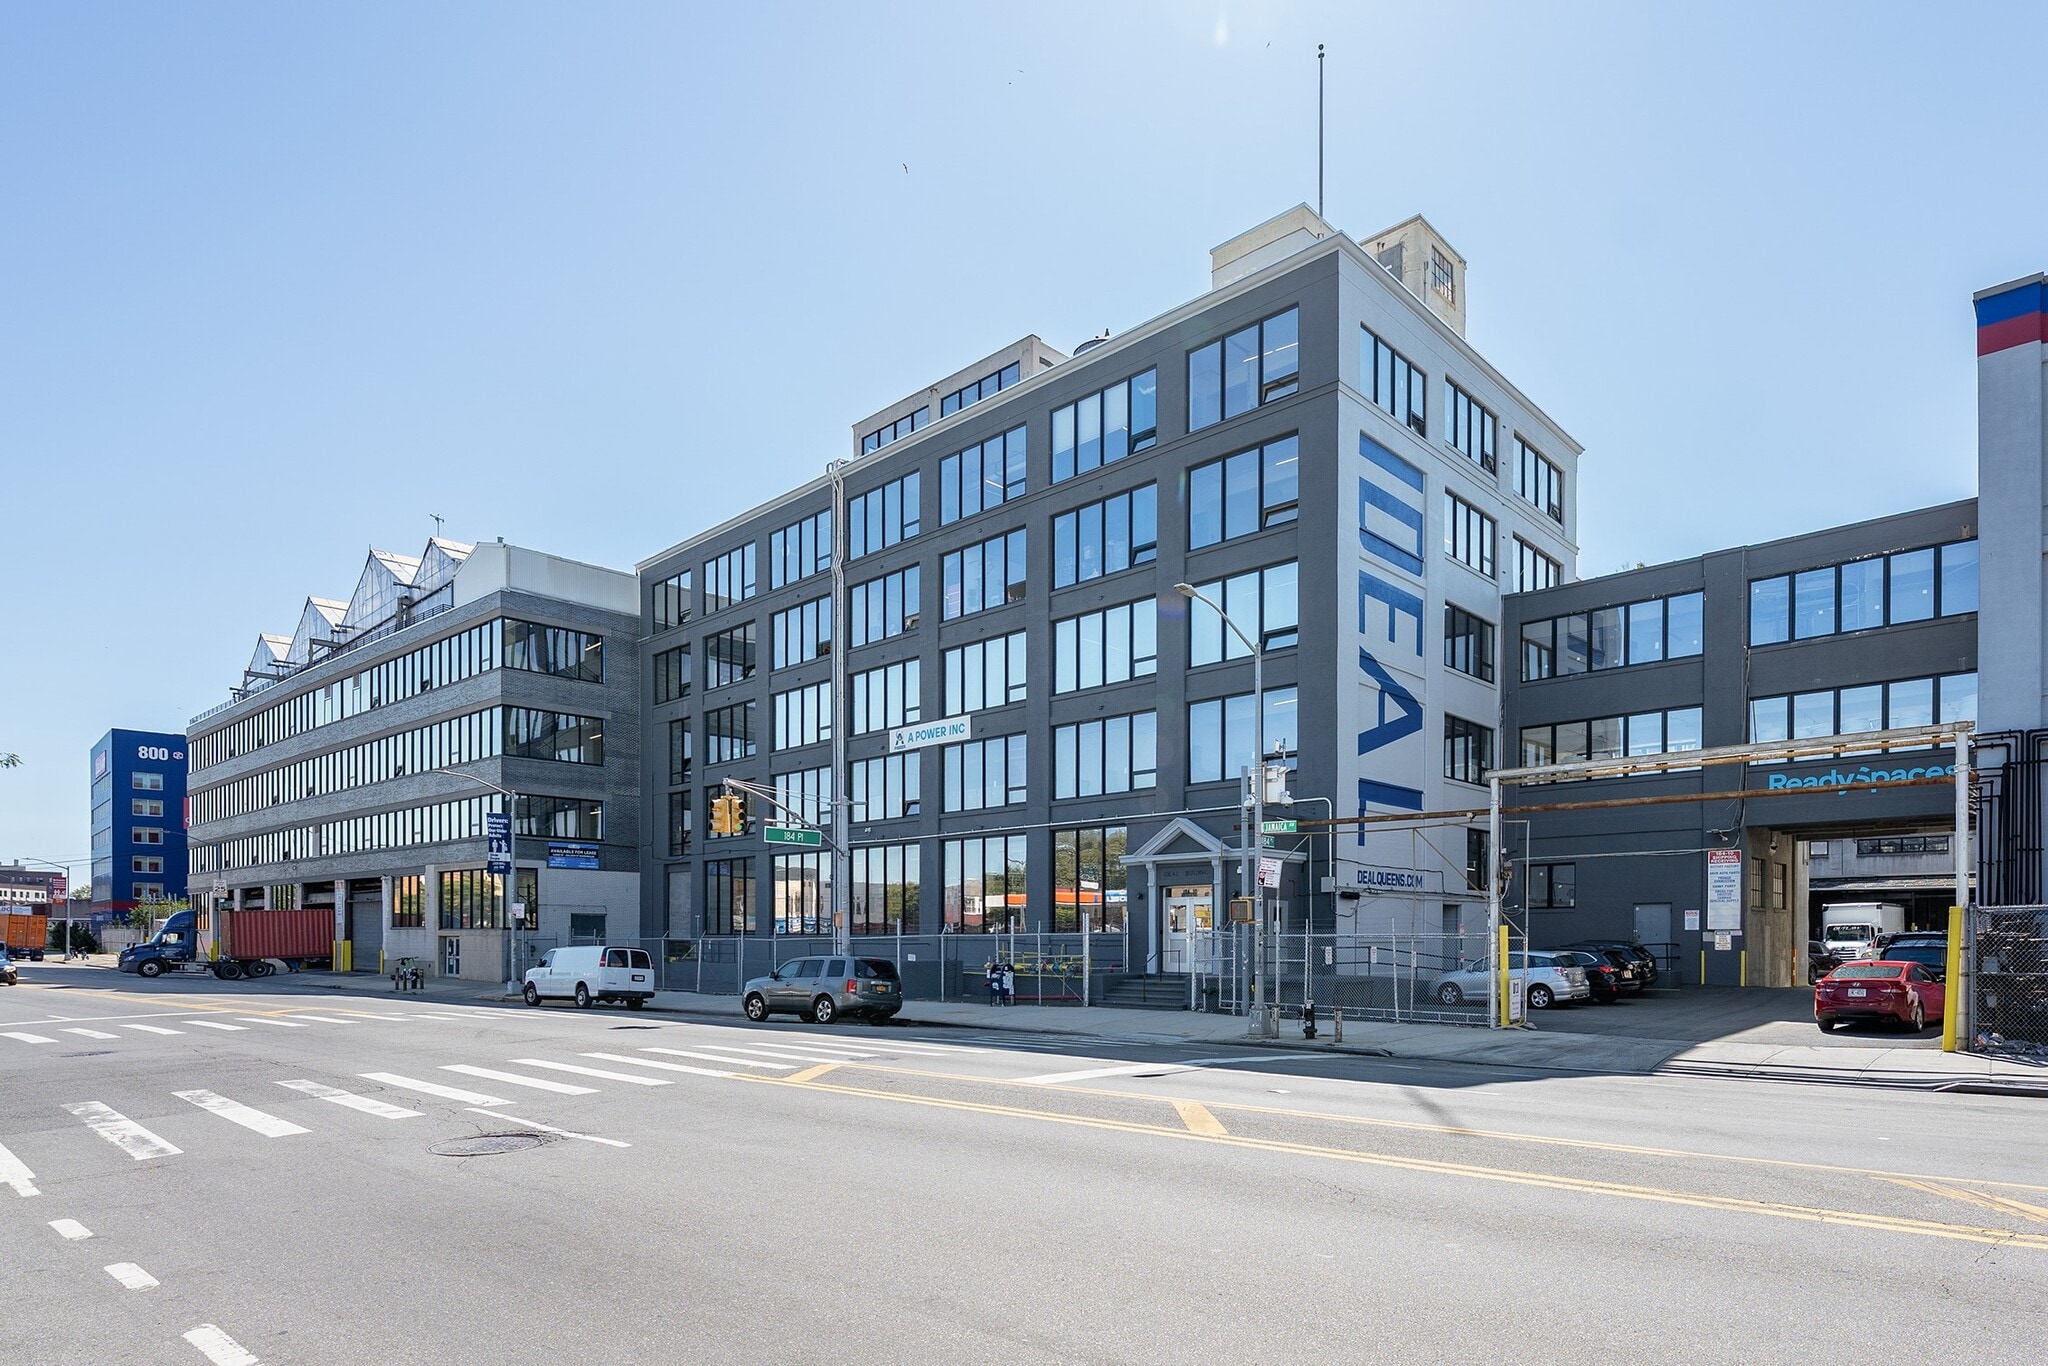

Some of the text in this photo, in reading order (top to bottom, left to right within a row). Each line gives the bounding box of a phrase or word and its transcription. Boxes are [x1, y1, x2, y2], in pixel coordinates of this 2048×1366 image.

[1357, 428, 1425, 847] IDEAL
[907, 723, 966, 744] A POWER INC
[138, 745, 169, 761] 800
[487, 816, 509, 824] Drivers:
[1264, 822, 1288, 832] JAMAICA
[784, 831, 795, 841] 184
[1357, 870, 1423, 888] DEALQUEENS.COM
[214, 885, 226, 893] 25
